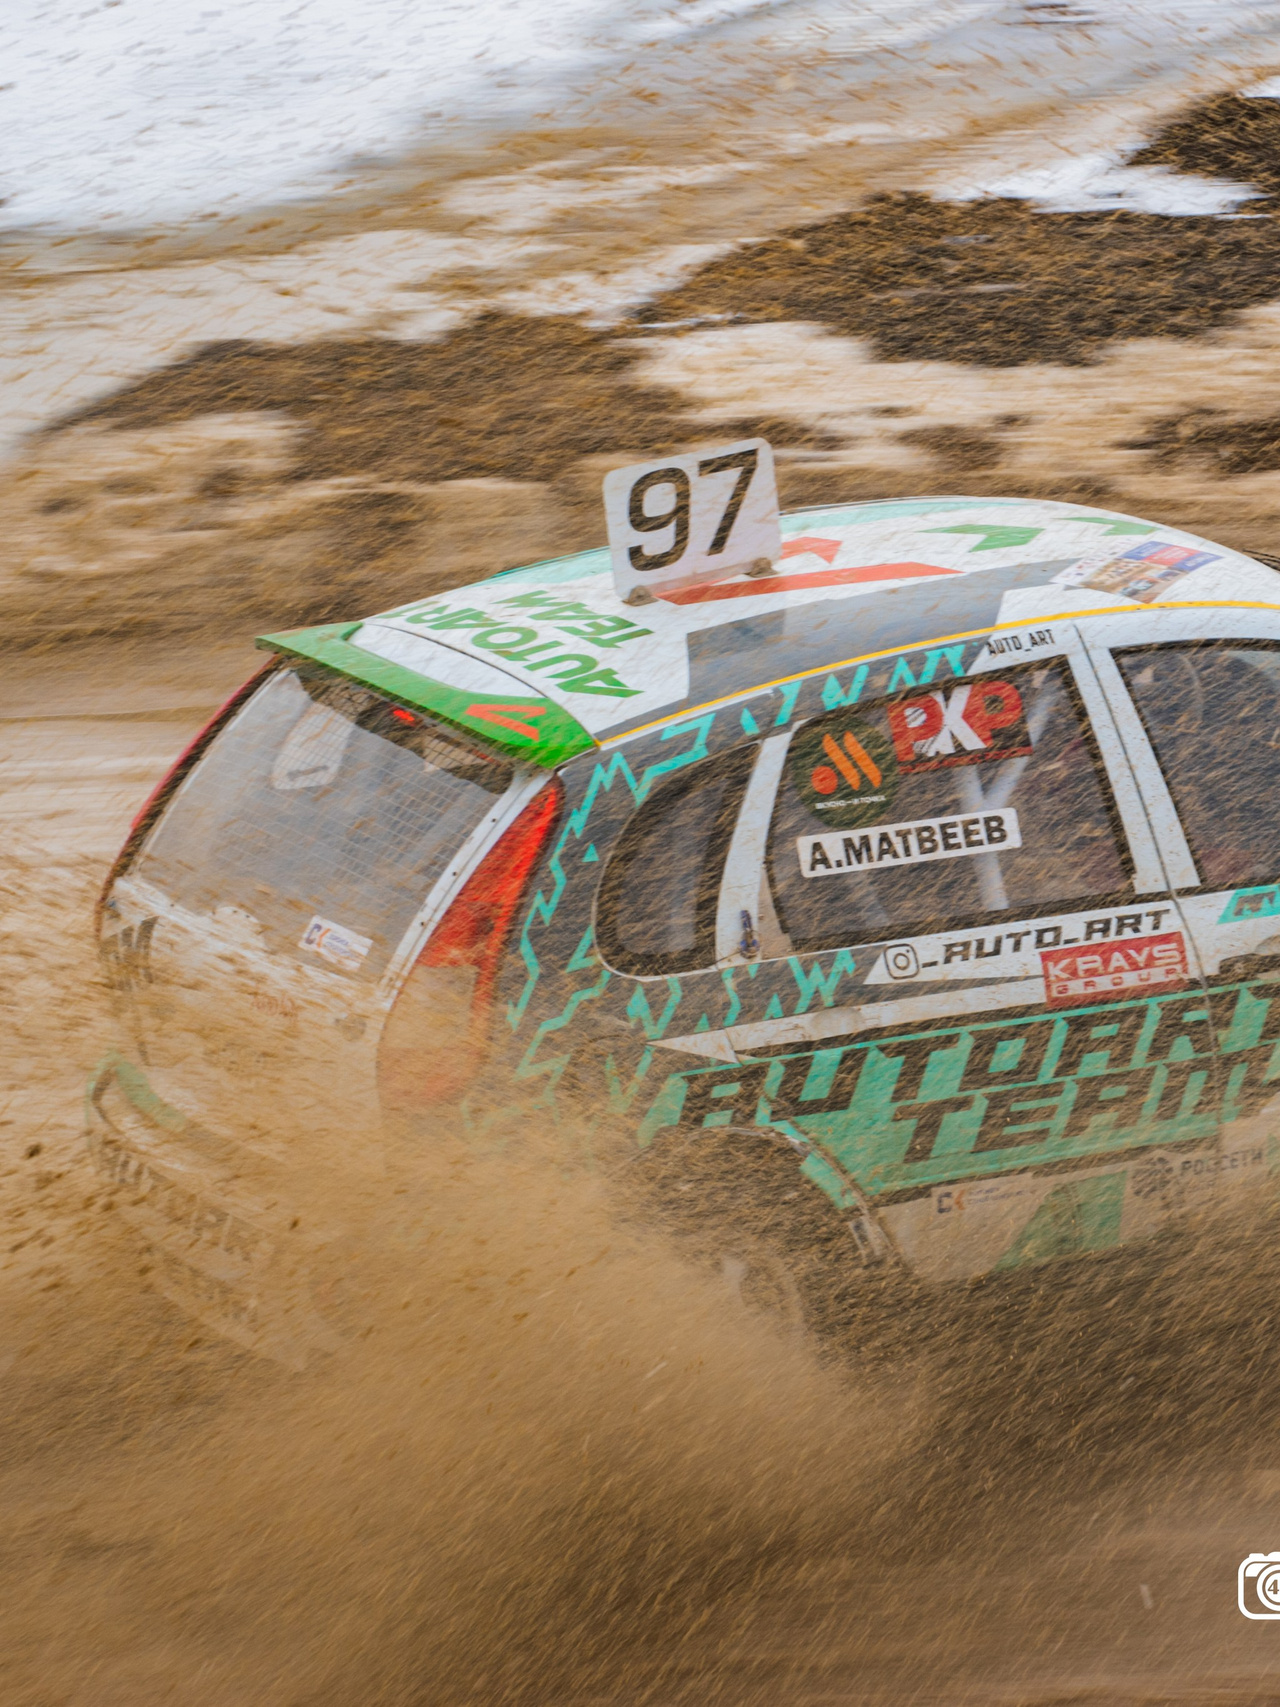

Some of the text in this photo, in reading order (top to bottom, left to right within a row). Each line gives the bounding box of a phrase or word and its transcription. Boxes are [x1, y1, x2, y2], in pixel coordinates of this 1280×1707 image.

[628, 448, 759, 571] 97
[490, 590, 654, 648] TEAM
[1047, 943, 1183, 981] KRAYS
[1056, 965, 1182, 995] GROUP
[890, 1042, 1278, 1165] TEAM
